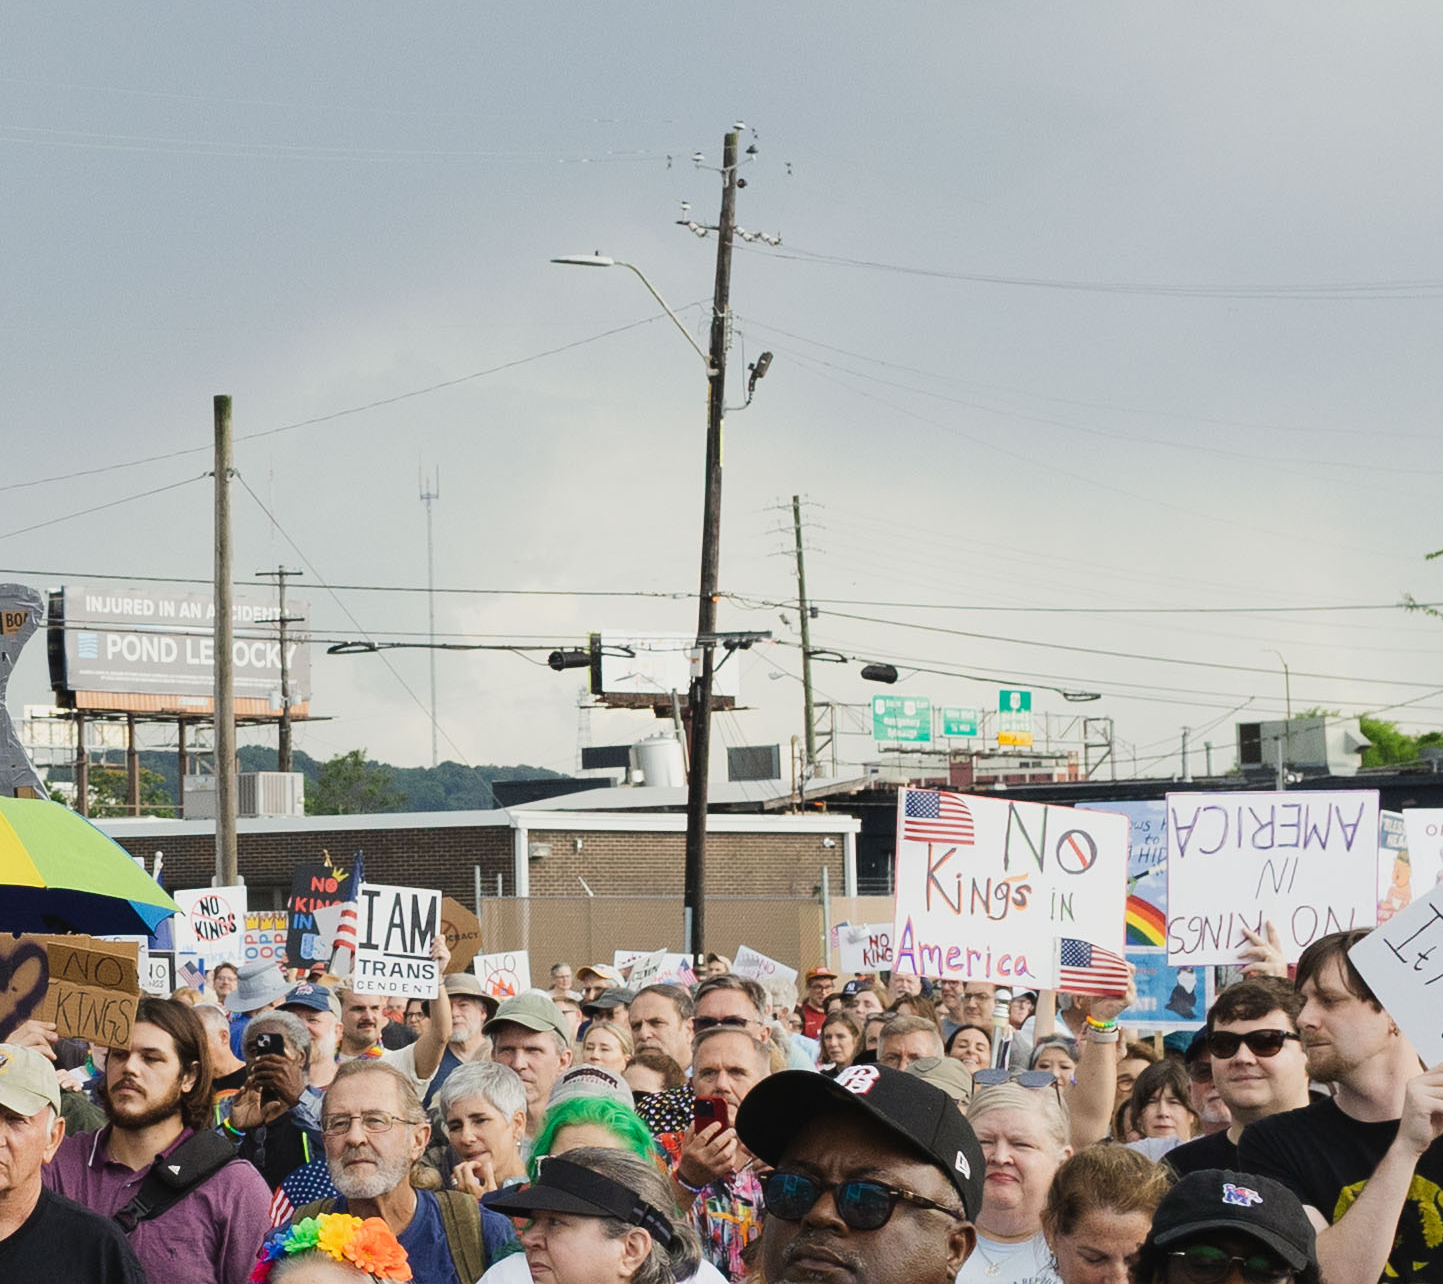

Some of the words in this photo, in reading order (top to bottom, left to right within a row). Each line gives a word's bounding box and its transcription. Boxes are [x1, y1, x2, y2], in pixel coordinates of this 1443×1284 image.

[86, 595, 154, 616] INJURED
[159, 601, 174, 617] IN
[179, 602, 202, 618] AN
[107, 634, 177, 664] POND
[186, 635, 297, 668] LEOCKY
[1171, 802, 1364, 858] AMERICA
[312, 875, 338, 893] NO
[1255, 857, 1299, 900] IN
[200, 897, 219, 916] NO
[293, 913, 312, 929] IN
[359, 890, 380, 950] I
[384, 893, 437, 956] AM
[869, 933, 889, 949] NO
[1291, 905, 1355, 947] NO
[895, 915, 1036, 979] America
[63, 951, 123, 986] NO
[359, 959, 434, 980] TRANS
[357, 980, 433, 994] CENDENT
[55, 988, 132, 1044] KINGS
